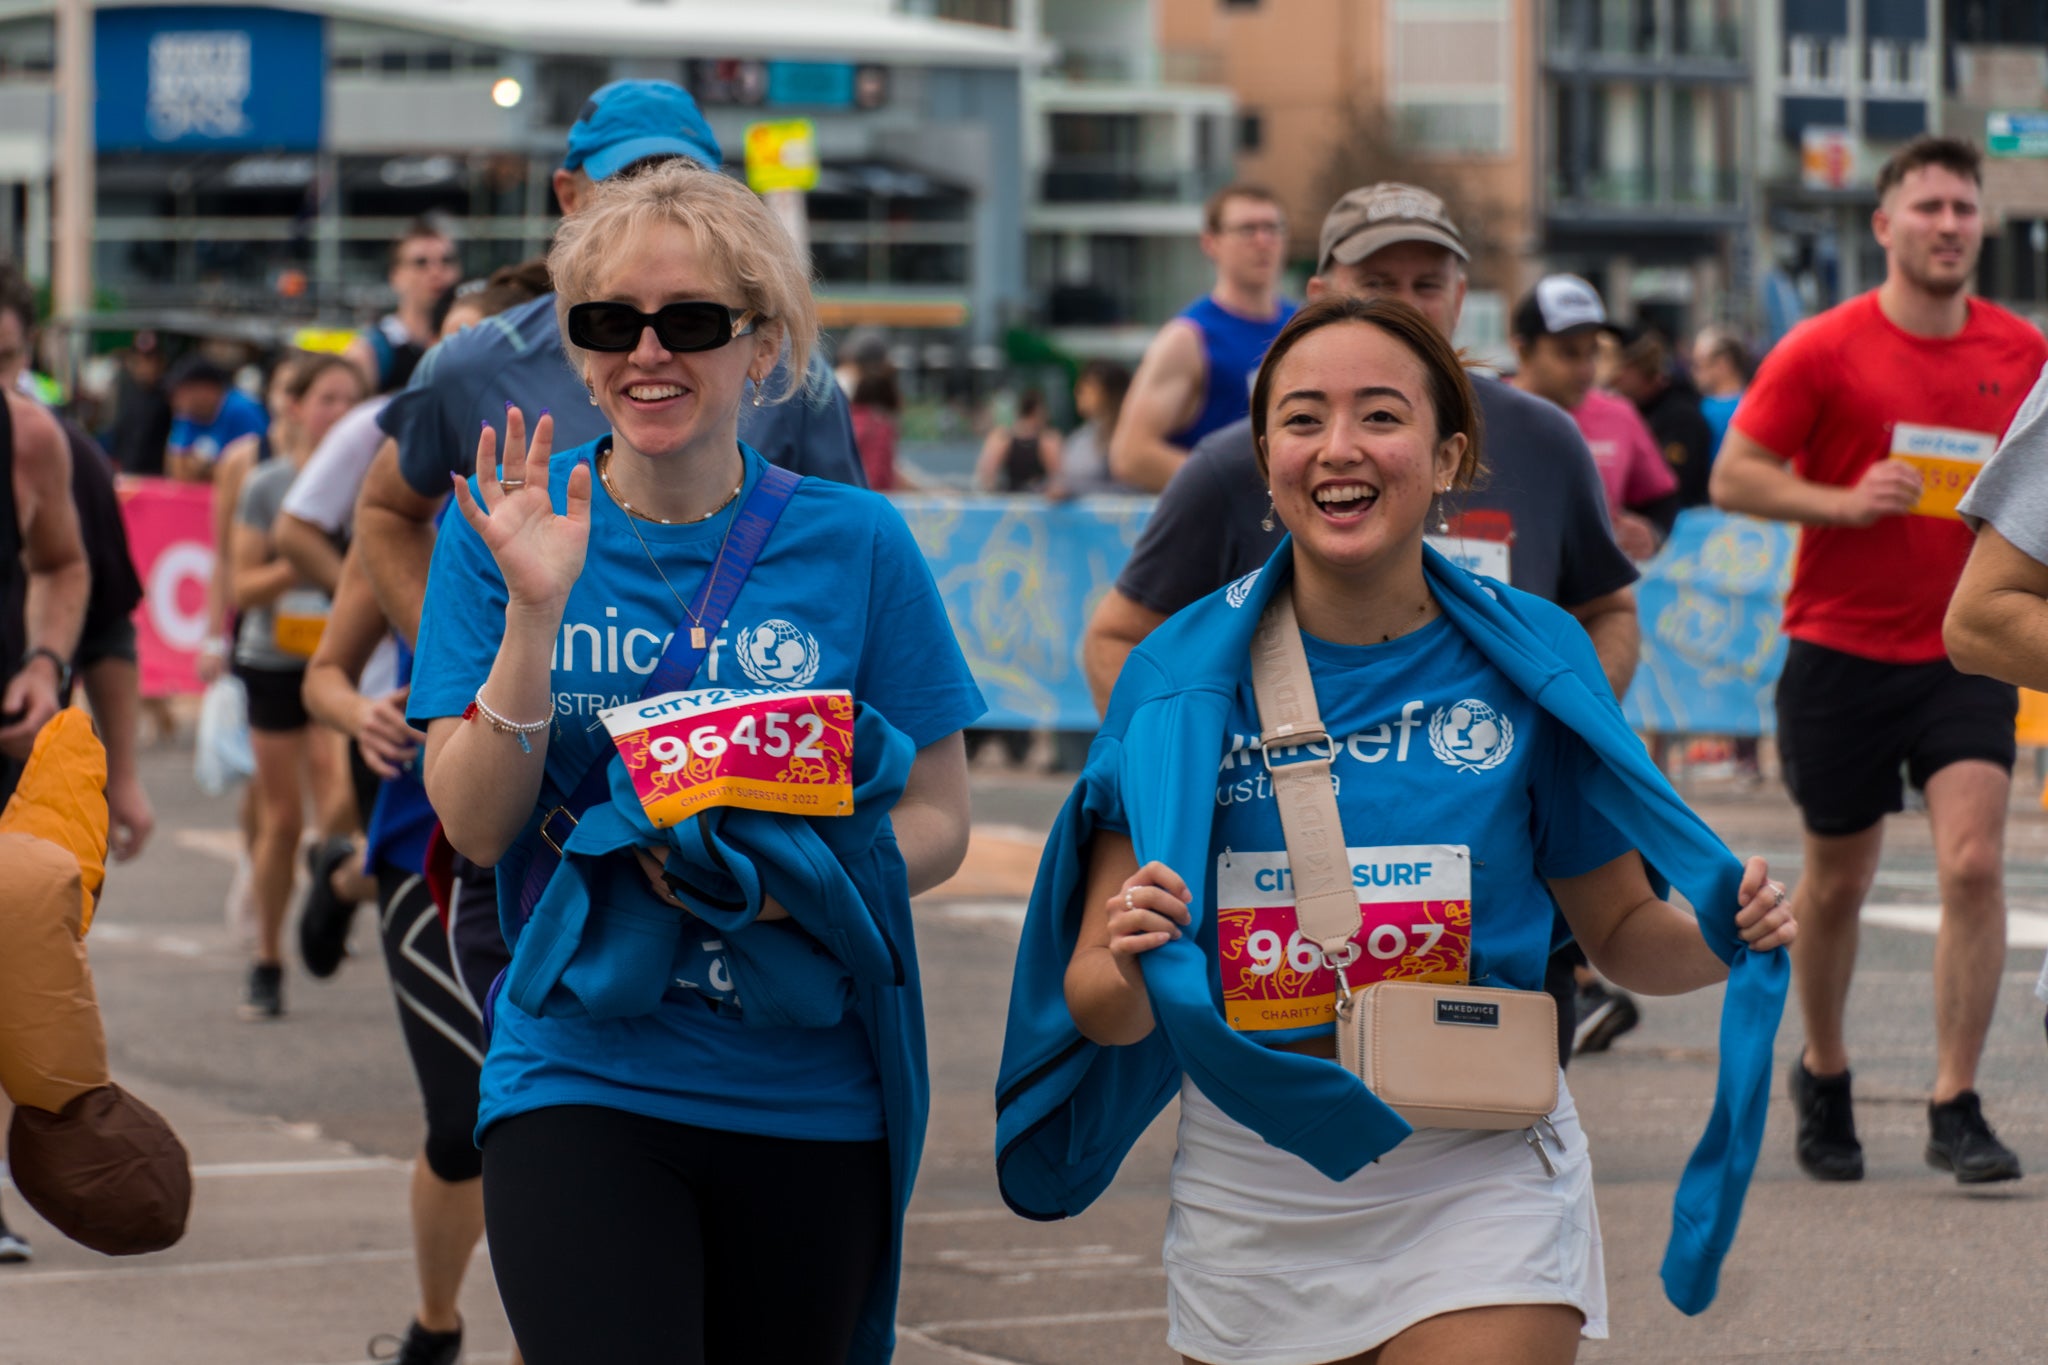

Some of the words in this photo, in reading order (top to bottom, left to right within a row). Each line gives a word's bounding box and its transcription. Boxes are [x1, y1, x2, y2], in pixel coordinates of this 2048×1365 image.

[550, 606, 729, 682] nicf
[638, 688, 798, 719] CITY2SU
[650, 712, 826, 774] 96452
[680, 786, 734, 807] CHARITY
[737, 787, 789, 803] SUPERSTAR
[792, 793, 819, 805] 2022
[1254, 862, 1433, 892] CITSURF
[1261, 1006, 1320, 1020] CHARITY
[1440, 1003, 1495, 1015] NAKEDVICE
